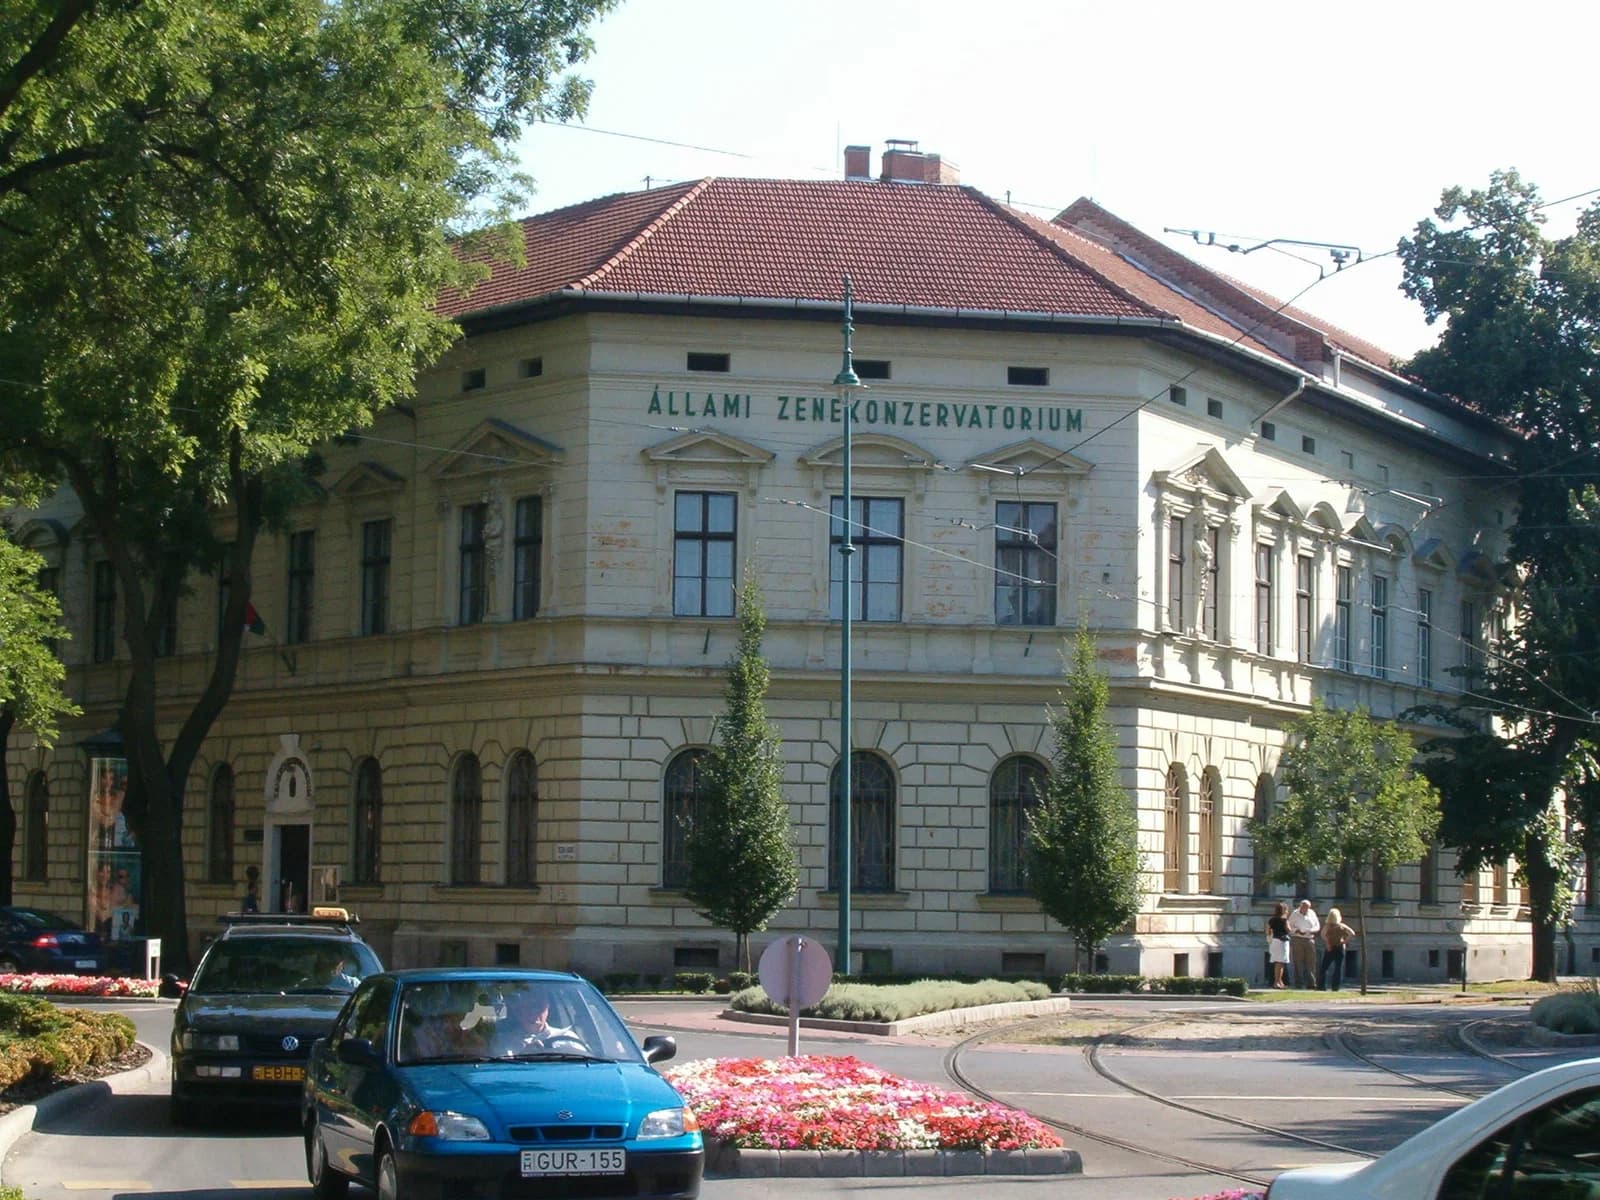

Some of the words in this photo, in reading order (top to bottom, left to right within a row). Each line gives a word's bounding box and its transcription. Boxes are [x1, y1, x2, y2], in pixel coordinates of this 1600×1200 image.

[647, 384, 750, 418] ÁLLAMI
[777, 395, 1083, 432] ZENEKONZERVATORIUM
[537, 1151, 623, 1170] GUR-155
